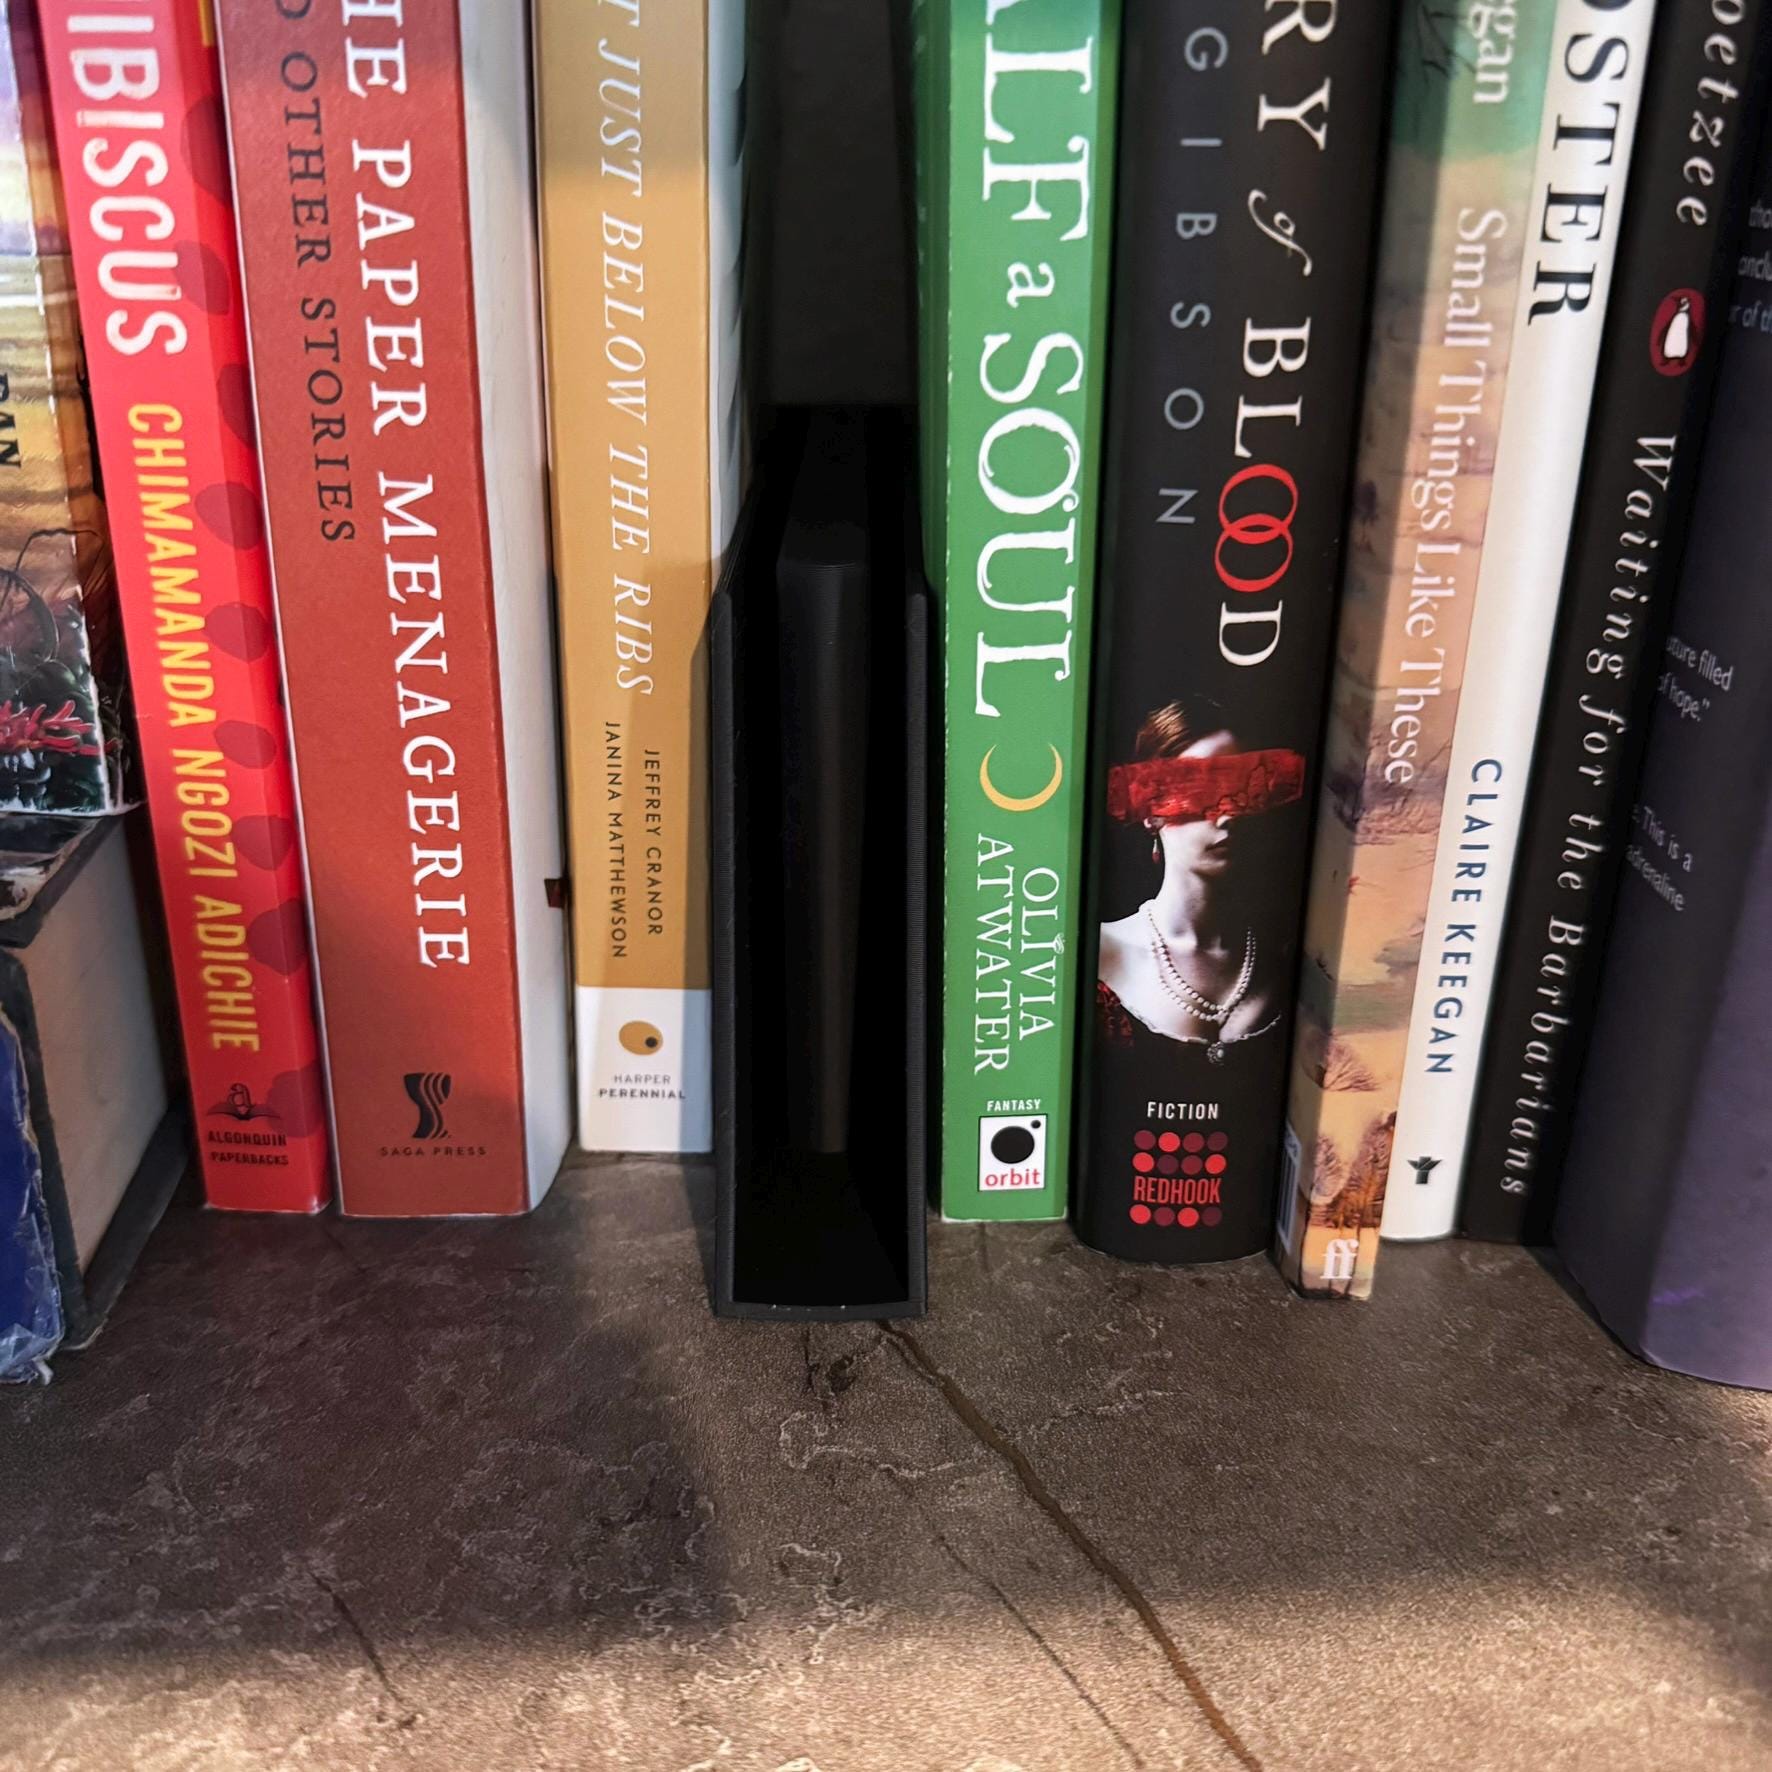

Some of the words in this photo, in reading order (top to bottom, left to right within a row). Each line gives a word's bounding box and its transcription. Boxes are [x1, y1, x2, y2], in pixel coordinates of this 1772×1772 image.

[67, 0, 188, 355] IBISCUS
[279, 52, 332, 268] OTHER
[598, 38, 642, 197] JUST
[982, 0, 1093, 242] LF
[352, 139, 428, 436] PAPER
[1006, 261, 1055, 308] a
[1156, 28, 1228, 524] GIBSON
[1248, 189, 1313, 276] of
[1444, 208, 1507, 347] Small
[601, 212, 647, 425] BELOW
[300, 297, 355, 543] STORIES
[1410, 359, 1493, 531] Things
[608, 443, 651, 554] THE
[974, 332, 1085, 717] SOUL
[1214, 317, 1312, 667] BLOOD
[1586, 435, 1676, 680] Waiting
[128, 404, 218, 727] CHIMAMANDA
[1405, 542, 1461, 637] Like
[613, 573, 653, 696] RIBS
[1698, 648, 1734, 693] filled
[378, 472, 471, 968] MENAGERIE
[605, 721, 622, 802] JANINA
[1384, 648, 1445, 784] These
[1578, 694, 1629, 786] for
[173, 750, 237, 879] NGOZI
[644, 749, 662, 837] JEFFREY
[1452, 757, 1503, 905] CLAIRE
[1557, 812, 1604, 890] the
[1667, 834, 1680, 860] is
[1682, 852, 1693, 873] a
[607, 812, 628, 959] MATTHEWSON
[646, 845, 664, 936] CRANOR
[194, 895, 259, 1051] ADICHIE
[974, 833, 1014, 1075] ATWATER
[1018, 867, 1064, 1040] OLIVIA
[1426, 922, 1479, 1074] KEEGAN
[598, 1087, 686, 1099] PERENNIAL
[613, 1073, 672, 1085] HARPER
[987, 1099, 1041, 1112] FANTASY
[1147, 1102, 1219, 1120] FICTION
[1500, 914, 1586, 1195] Barbarians
[207, 1129, 288, 1147] ALGONQUIN
[210, 1150, 289, 1166] PAPERBACKS
[381, 1145, 425, 1157] SAGA
[429, 1145, 487, 1157] PRESS
[984, 1168, 1040, 1187] orbit
[1133, 1175, 1223, 1205] REDHOOK
[1320, 1238, 1360, 1280] ff
